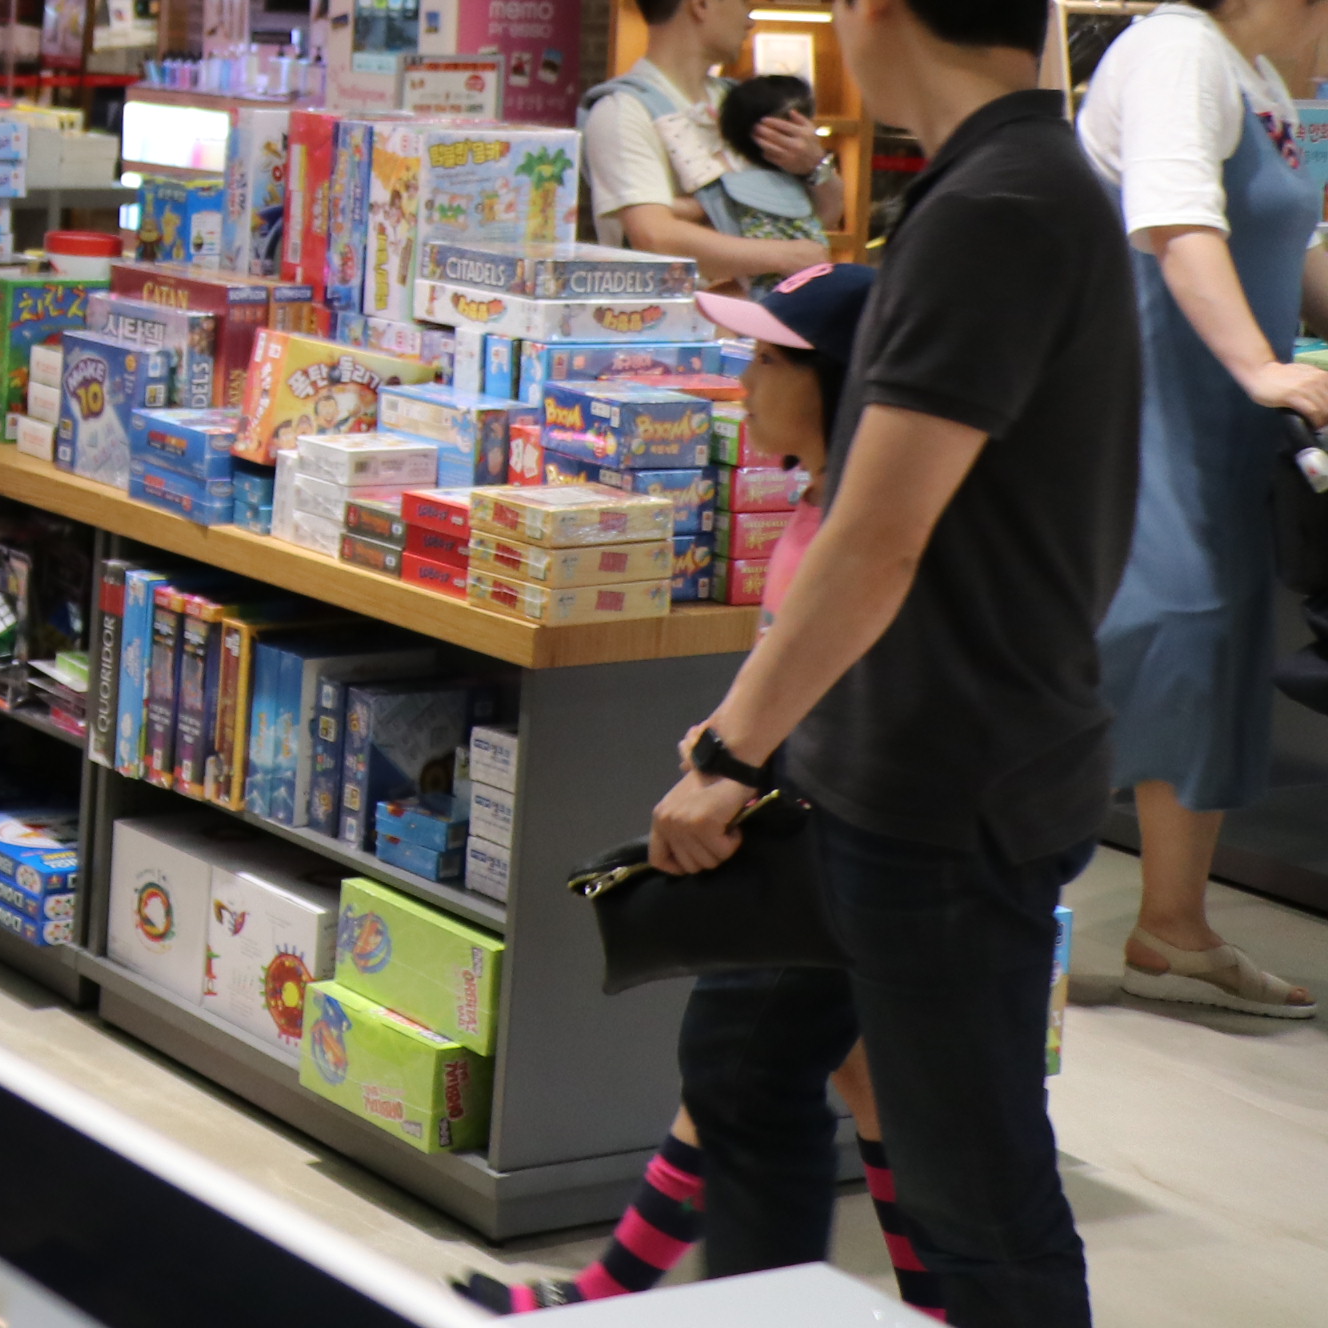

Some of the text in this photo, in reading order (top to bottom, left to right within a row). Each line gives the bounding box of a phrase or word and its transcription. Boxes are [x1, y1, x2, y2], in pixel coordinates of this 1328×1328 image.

[445, 256, 506, 287] CITADELS
[570, 269, 656, 294] CITADELS
[65, 358, 106, 393] MAKE
[75, 381, 104, 418] 10
[97, 615, 116, 734] QUORIDOR
